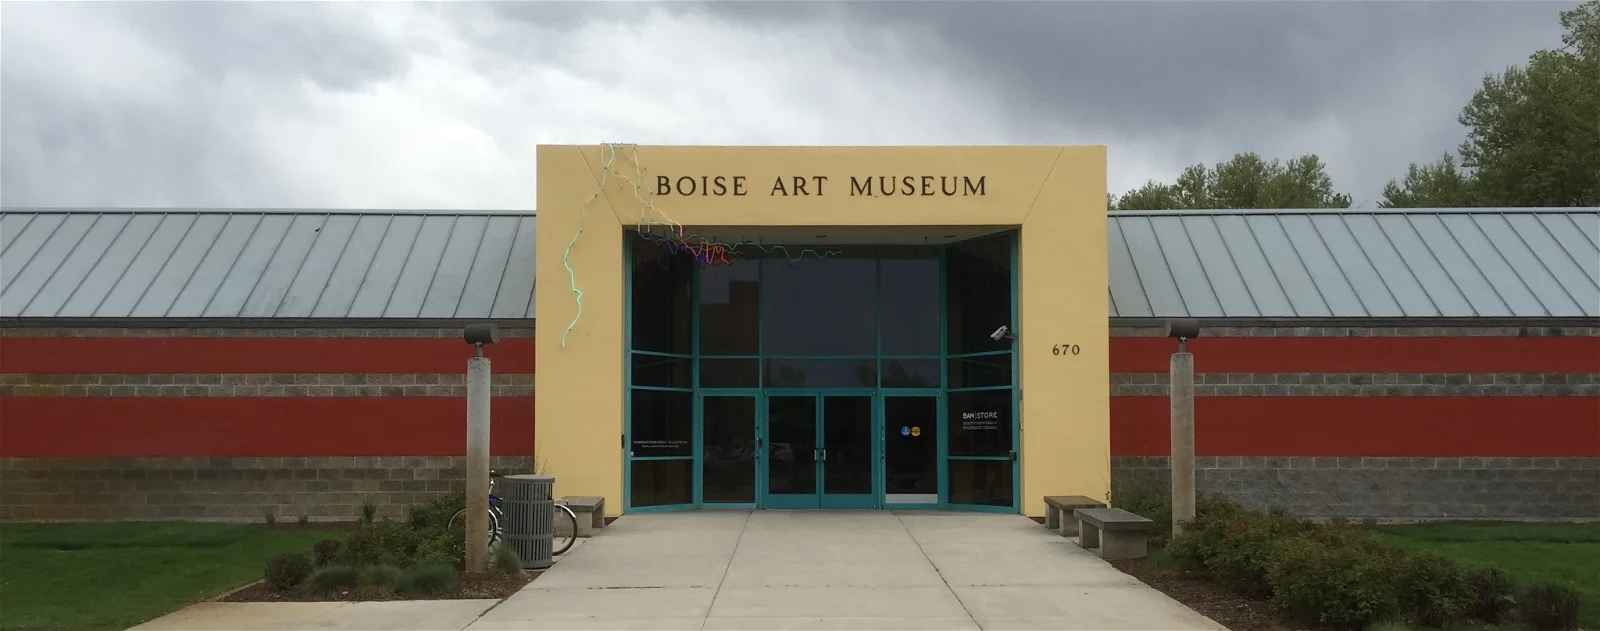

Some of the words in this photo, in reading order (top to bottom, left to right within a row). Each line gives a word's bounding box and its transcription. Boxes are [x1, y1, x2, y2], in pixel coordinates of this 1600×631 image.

[656, 175, 748, 197] BOISE
[769, 175, 829, 197] ART
[849, 175, 987, 197] MUSEUM
[1052, 343, 1080, 356] 670
[976, 411, 998, 419] STORE
